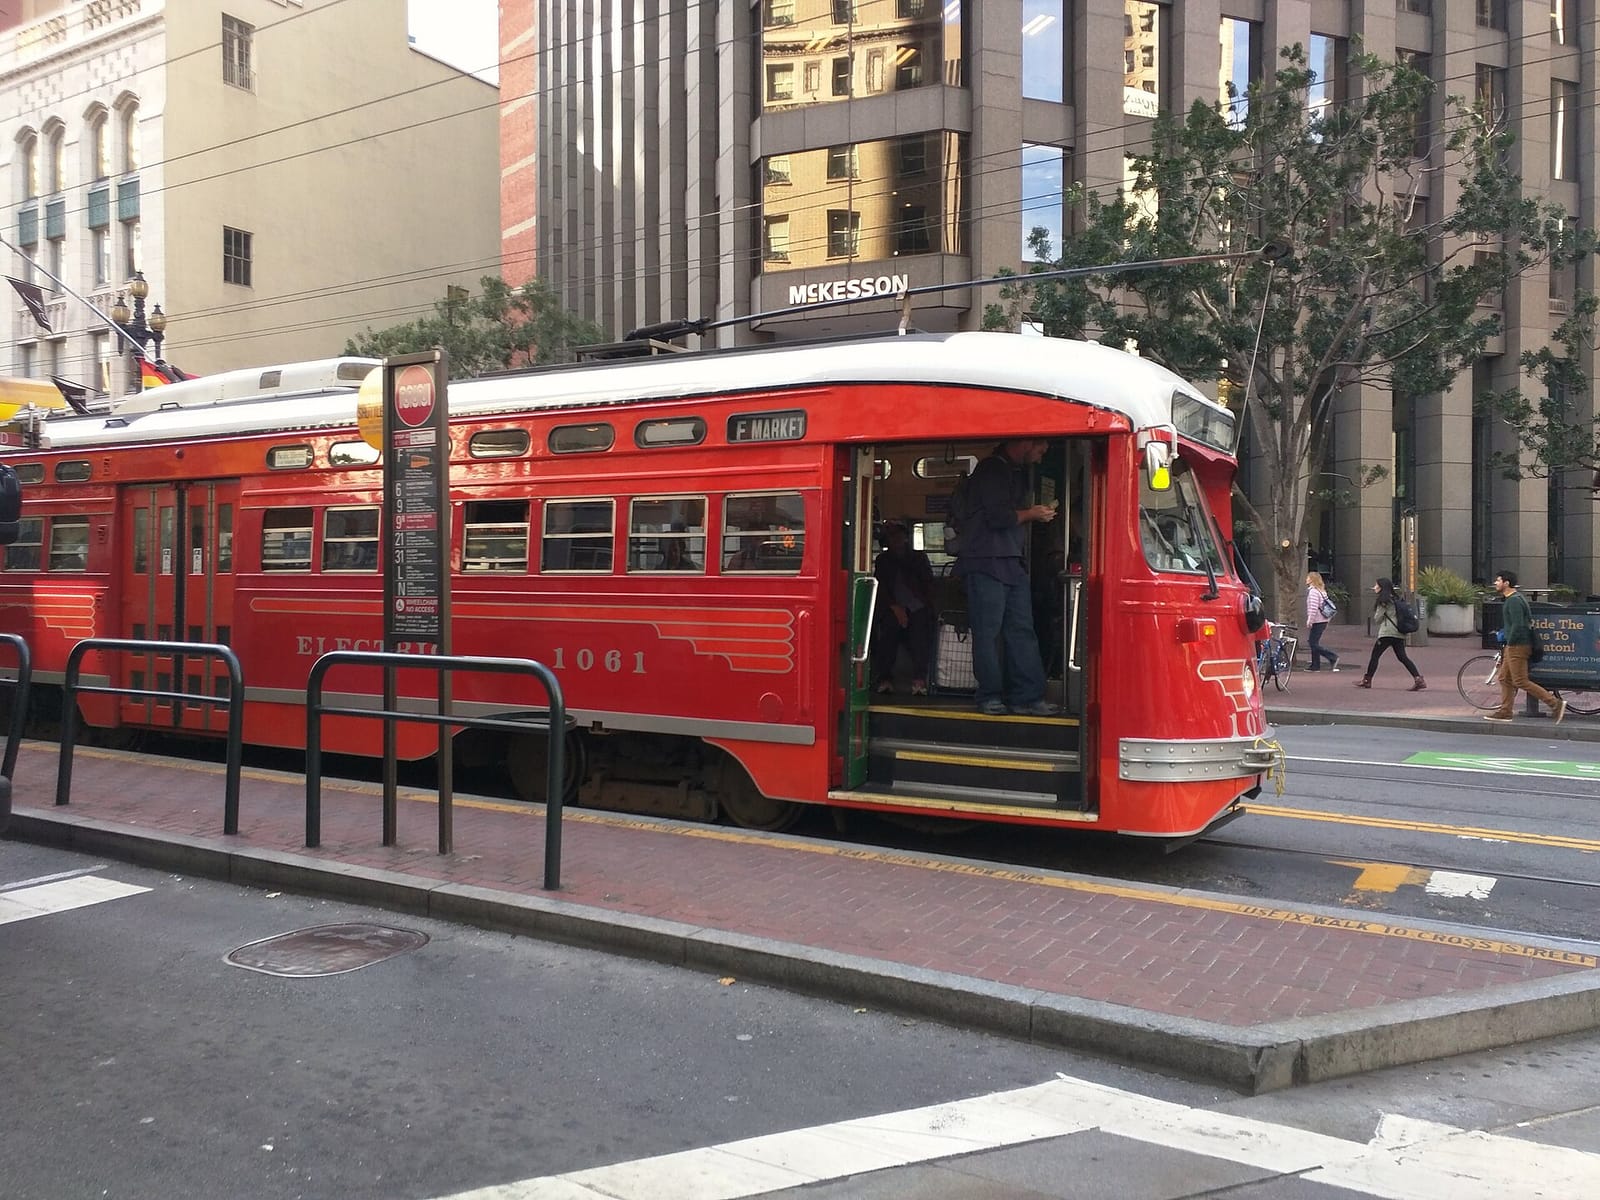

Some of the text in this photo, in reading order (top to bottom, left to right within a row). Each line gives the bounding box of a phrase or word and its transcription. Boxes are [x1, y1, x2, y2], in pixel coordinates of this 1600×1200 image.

[751, 415, 806, 440] MARKET
[397, 448, 404, 463] F
[395, 482, 402, 497] 6
[396, 499, 403, 513] 9
[394, 532, 404, 546] 21
[394, 549, 404, 564] 31
[397, 565, 404, 580] L
[397, 582, 406, 596] N
[1559, 619, 1584, 630] The
[1553, 630, 1569, 641] To
[552, 647, 647, 674] 1061
[1243, 906, 1278, 918] USE
[1383, 925, 1408, 936] TO
[1417, 931, 1492, 949] CROSS
[1503, 944, 1595, 964] STREET
